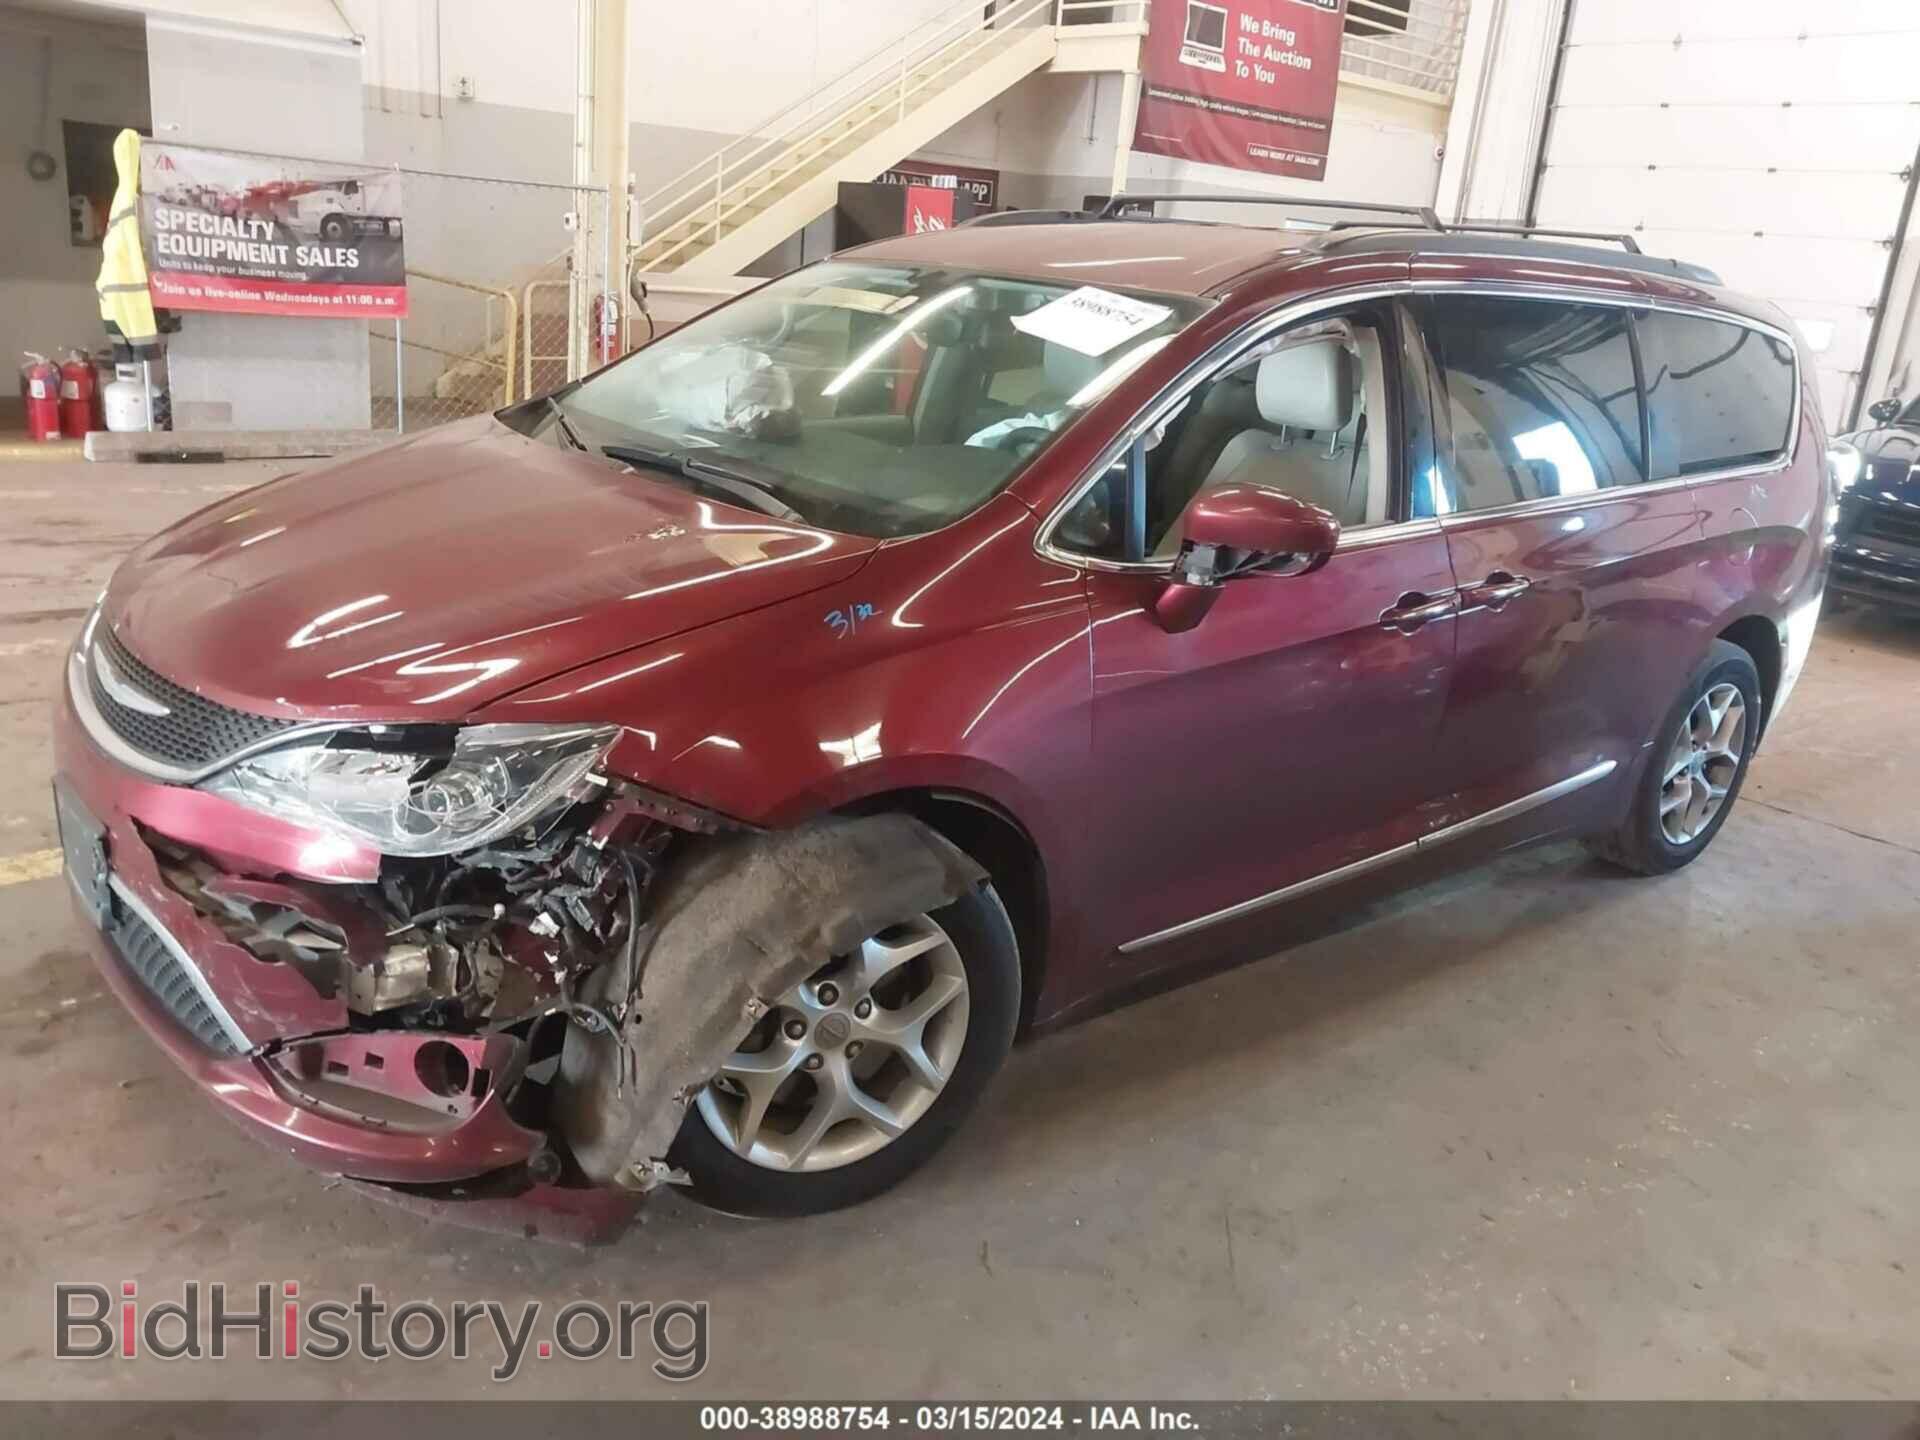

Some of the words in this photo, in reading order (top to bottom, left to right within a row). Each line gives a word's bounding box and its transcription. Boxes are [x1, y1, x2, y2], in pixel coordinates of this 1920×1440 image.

[1240, 12, 1260, 33] We
[1262, 19, 1295, 47] Bring
[1238, 36, 1261, 57] The
[1263, 43, 1312, 71] Auction
[1235, 59, 1250, 79] To
[1254, 63, 1276, 85] You
[155, 207, 275, 241] SPECIALTY
[157, 232, 288, 265] EQUIPMENT
[296, 245, 360, 269] SALES
[158, 257, 181, 269] Units
[182, 260, 193, 271] to
[193, 261, 215, 274] keep
[215, 265, 236, 275] your
[238, 265, 276, 278] business
[160, 281, 186, 295] Join
[188, 286, 202, 297] us
[204, 285, 261, 301] live-online
[264, 290, 330, 305] Wednesdays
[332, 293, 343, 304] at
[346, 293, 373, 305] 11:00
